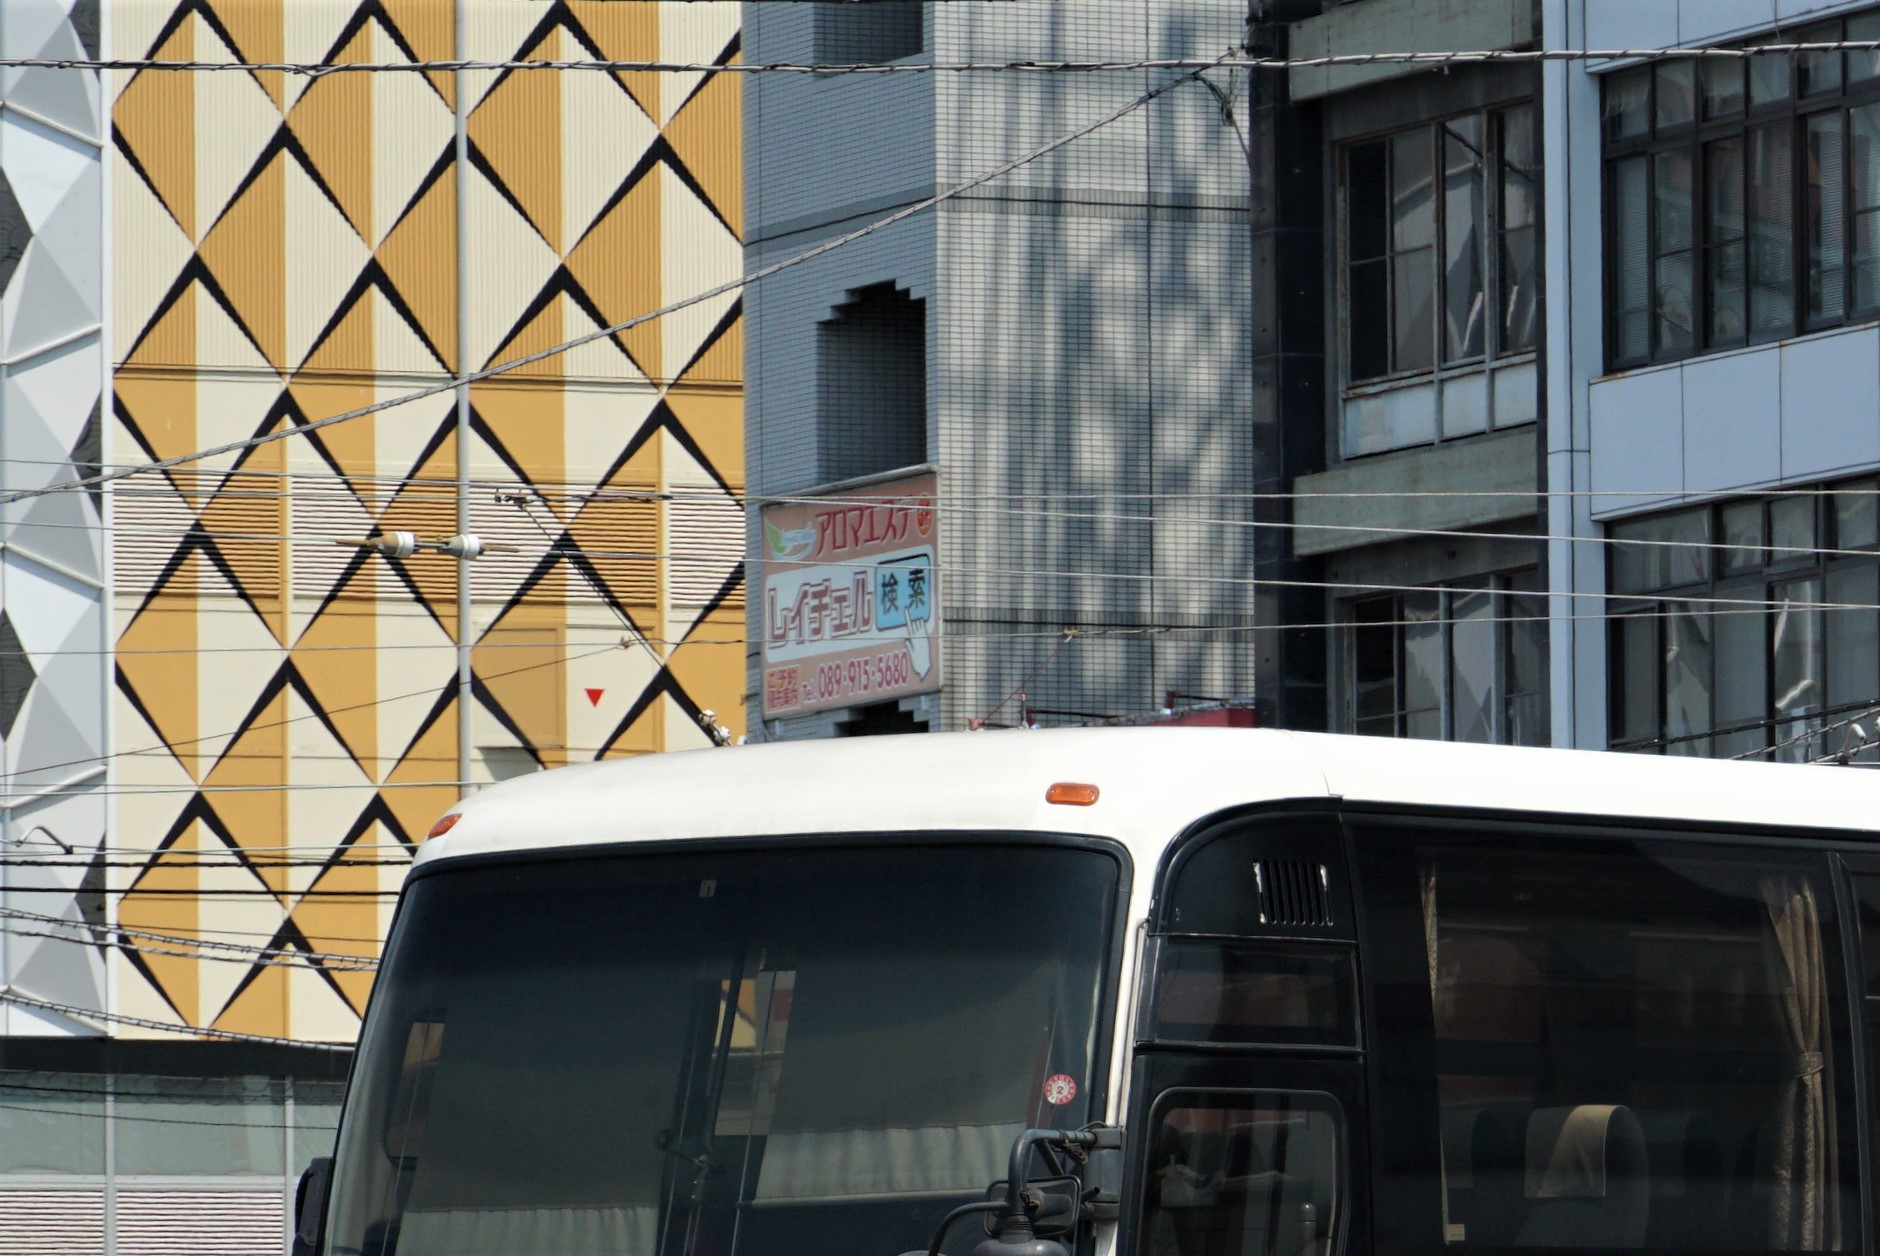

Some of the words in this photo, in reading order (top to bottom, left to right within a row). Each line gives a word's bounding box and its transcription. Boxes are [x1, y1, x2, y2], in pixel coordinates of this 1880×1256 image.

[815, 495, 917, 556] アロマエステ
[768, 571, 874, 650] レイチェル
[881, 568, 926, 614] 検索
